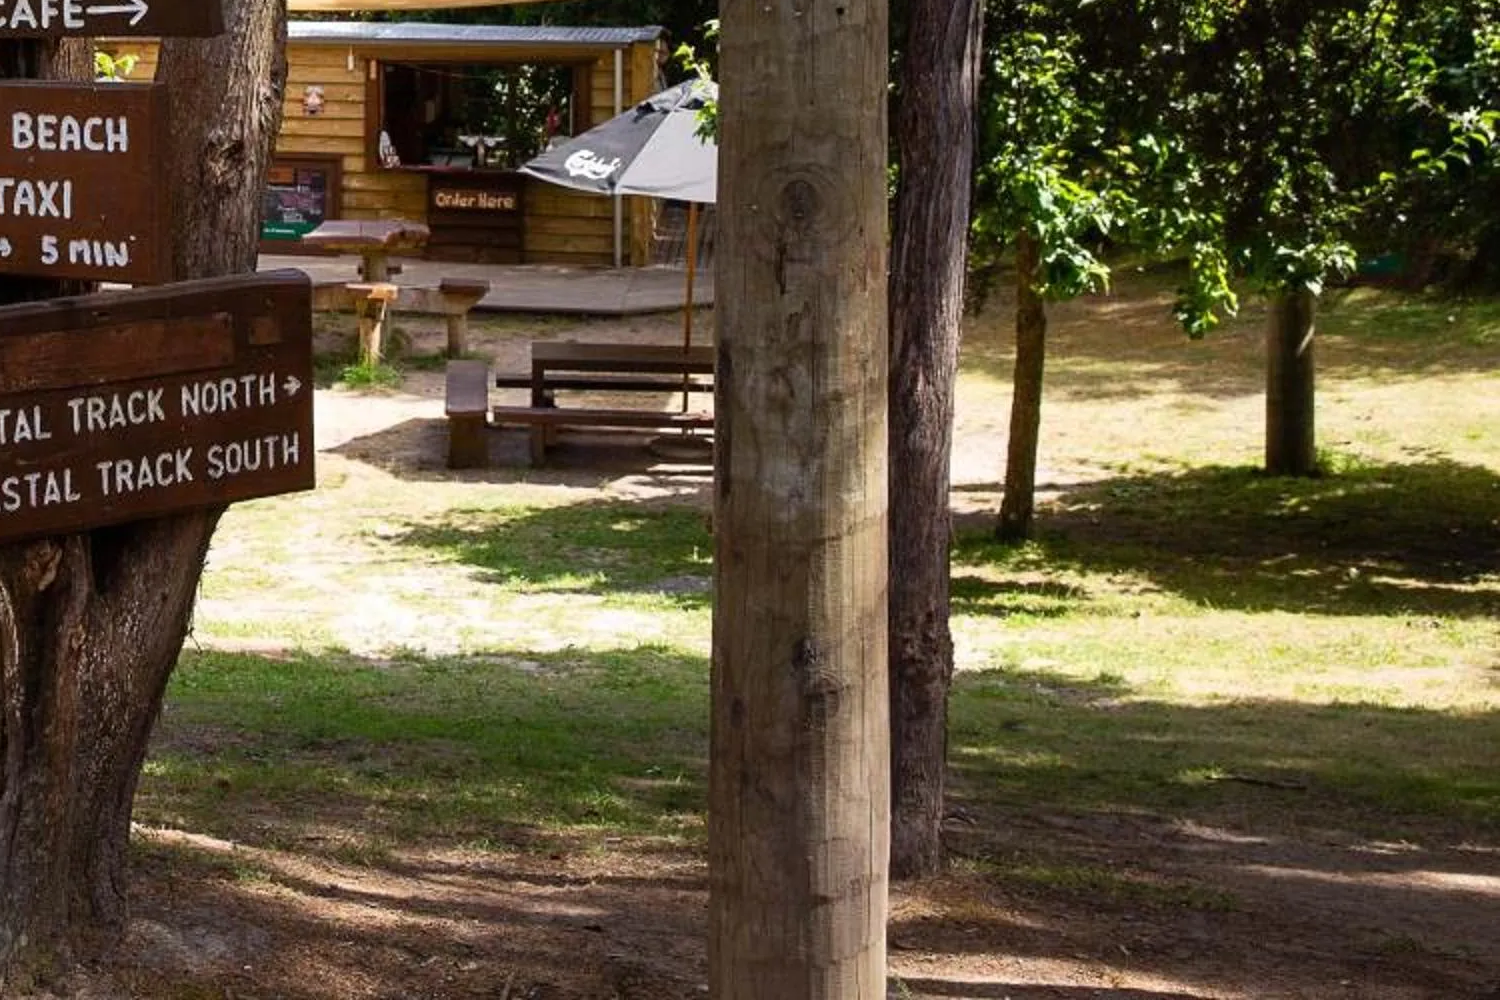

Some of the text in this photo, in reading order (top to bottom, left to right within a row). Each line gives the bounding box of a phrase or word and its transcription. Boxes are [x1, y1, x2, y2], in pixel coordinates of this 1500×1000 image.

[12, 112, 128, 152] BEACH
[436, 192, 514, 208] Order Here
[41, 234, 129, 267] 5 MIN
[67, 388, 165, 435] TRACK
[181, 372, 276, 416] NORTH
[97, 448, 194, 495] TRACK
[207, 432, 299, 479] SOUTH
